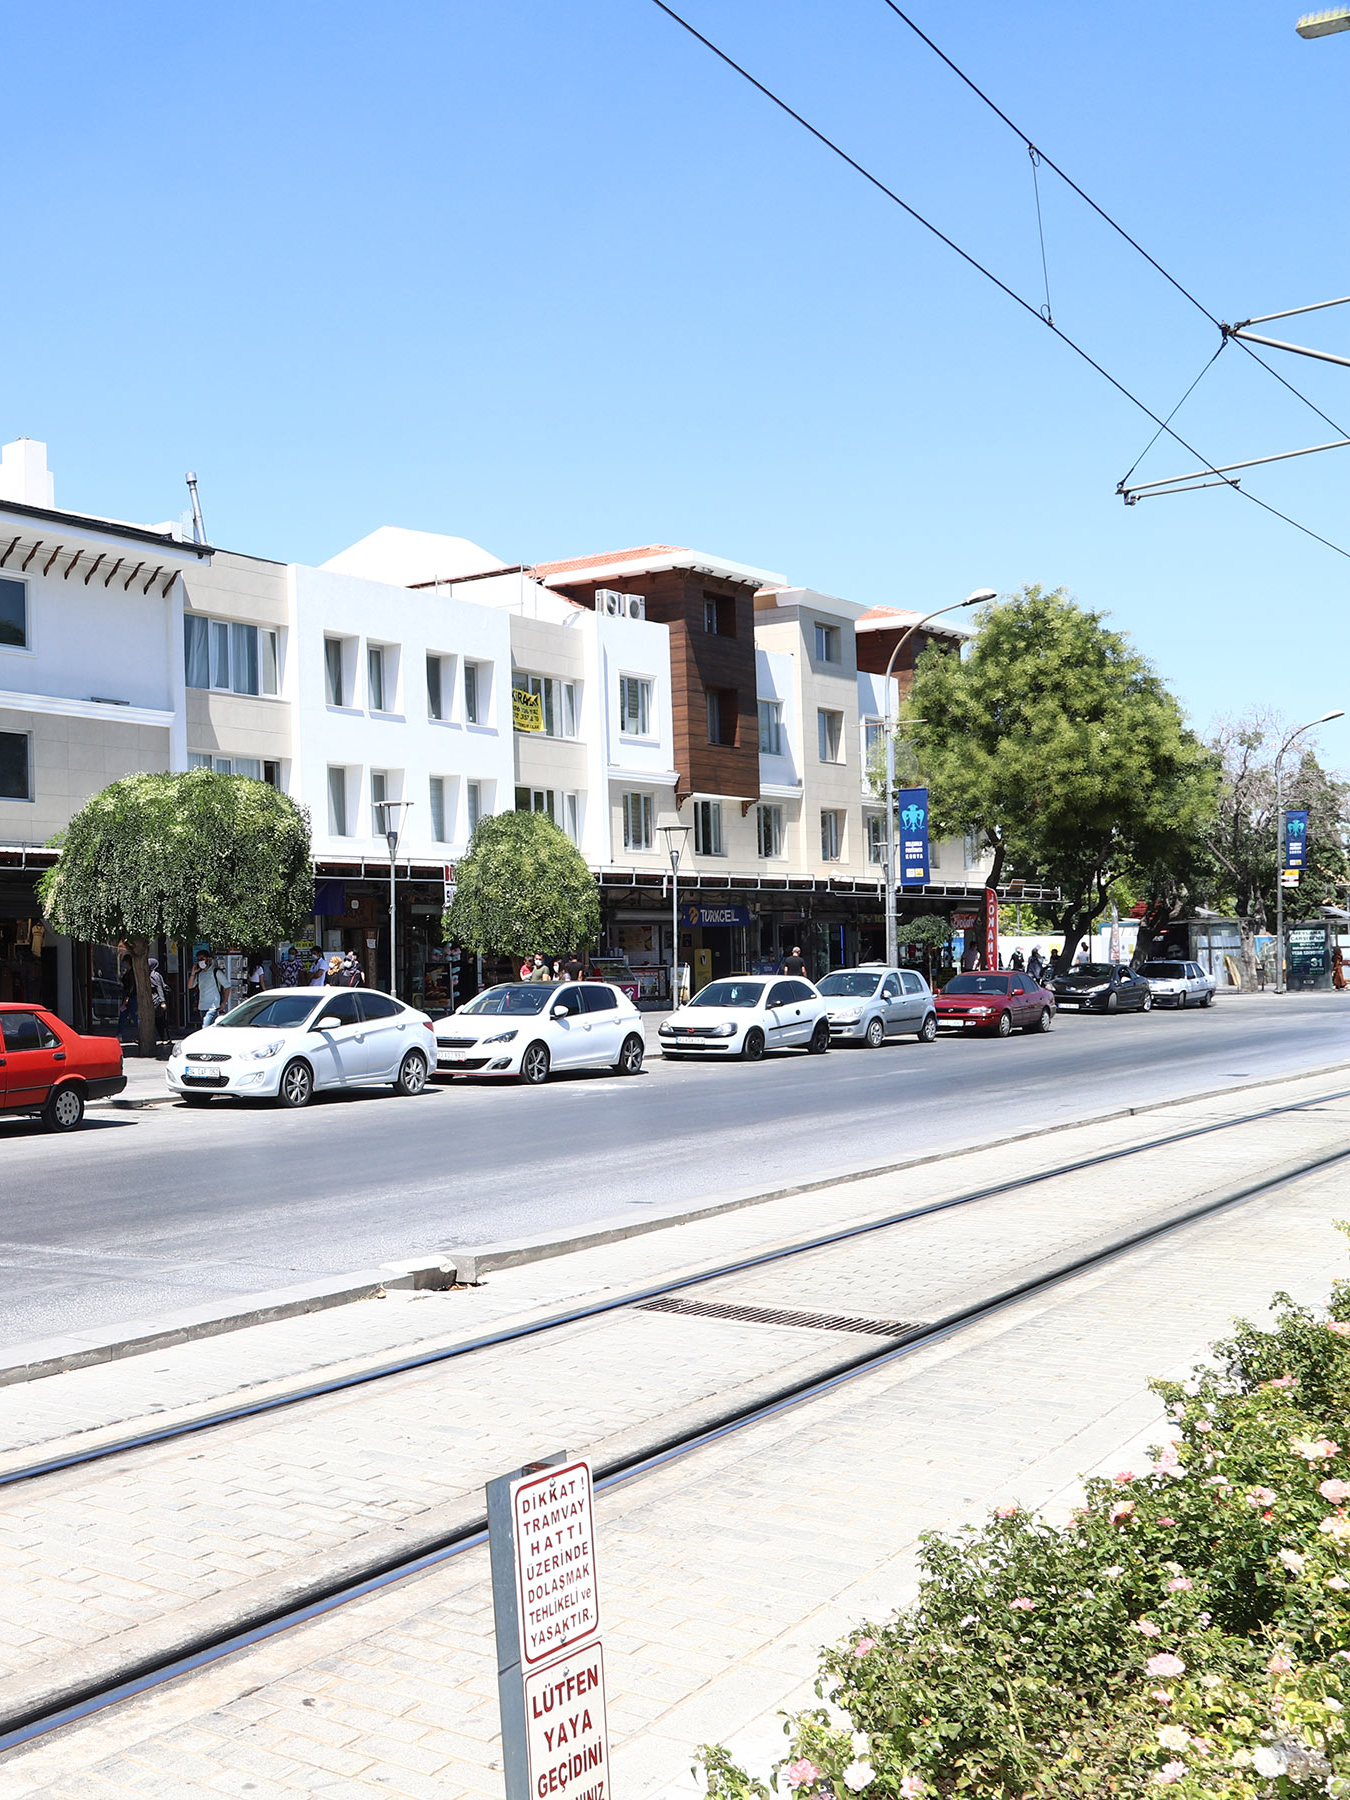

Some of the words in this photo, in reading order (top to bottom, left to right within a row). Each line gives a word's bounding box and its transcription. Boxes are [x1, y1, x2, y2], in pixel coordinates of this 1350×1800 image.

[1310, 958, 1323, 967] 31
[522, 1478, 576, 1515] DİKKAT
[523, 1498, 585, 1536] TRAMVAY
[530, 1521, 583, 1557] HATTI
[526, 1541, 589, 1581] ÜZERİNDE
[528, 1563, 590, 1604] DOLAŞMAK
[529, 1586, 579, 1626] TEHLİKELİ
[580, 1588, 592, 1602] ve
[530, 1606, 594, 1648] YASAKTIR.
[532, 1663, 599, 1720] LÜTFEN
[543, 1708, 593, 1753] YAYA
[537, 1741, 603, 1799] GEÇİDİNİ
